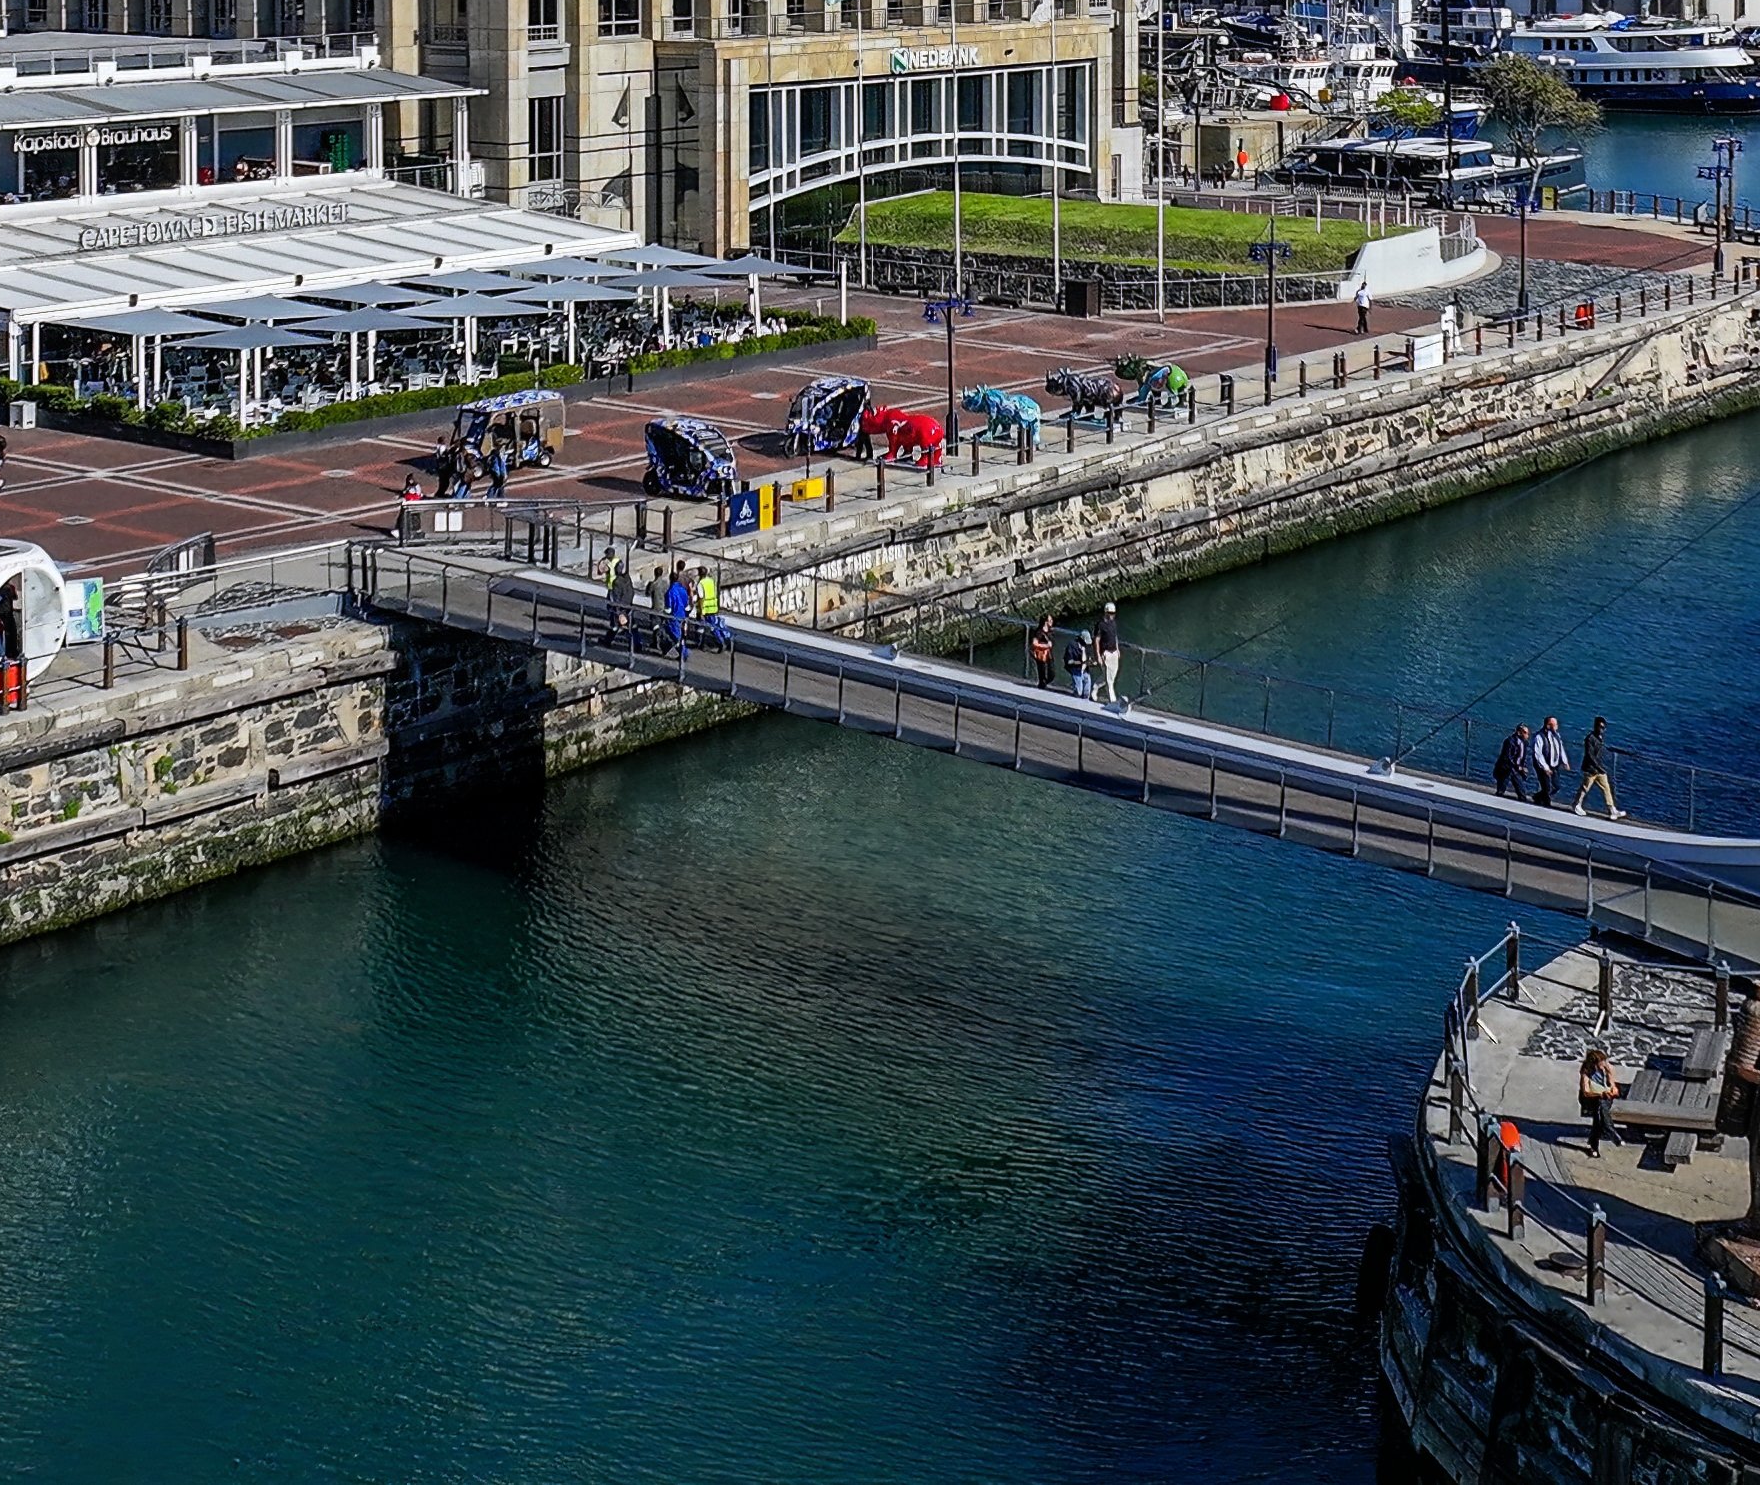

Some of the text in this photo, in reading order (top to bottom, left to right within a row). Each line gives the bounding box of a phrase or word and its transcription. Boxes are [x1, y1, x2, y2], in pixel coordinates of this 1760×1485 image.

[909, 46, 979, 69] NEDBANK
[101, 126, 173, 146] Brauhaus
[79, 202, 349, 250] CAPE TOWN FISH MARKET
[845, 550, 872, 576] THIS
